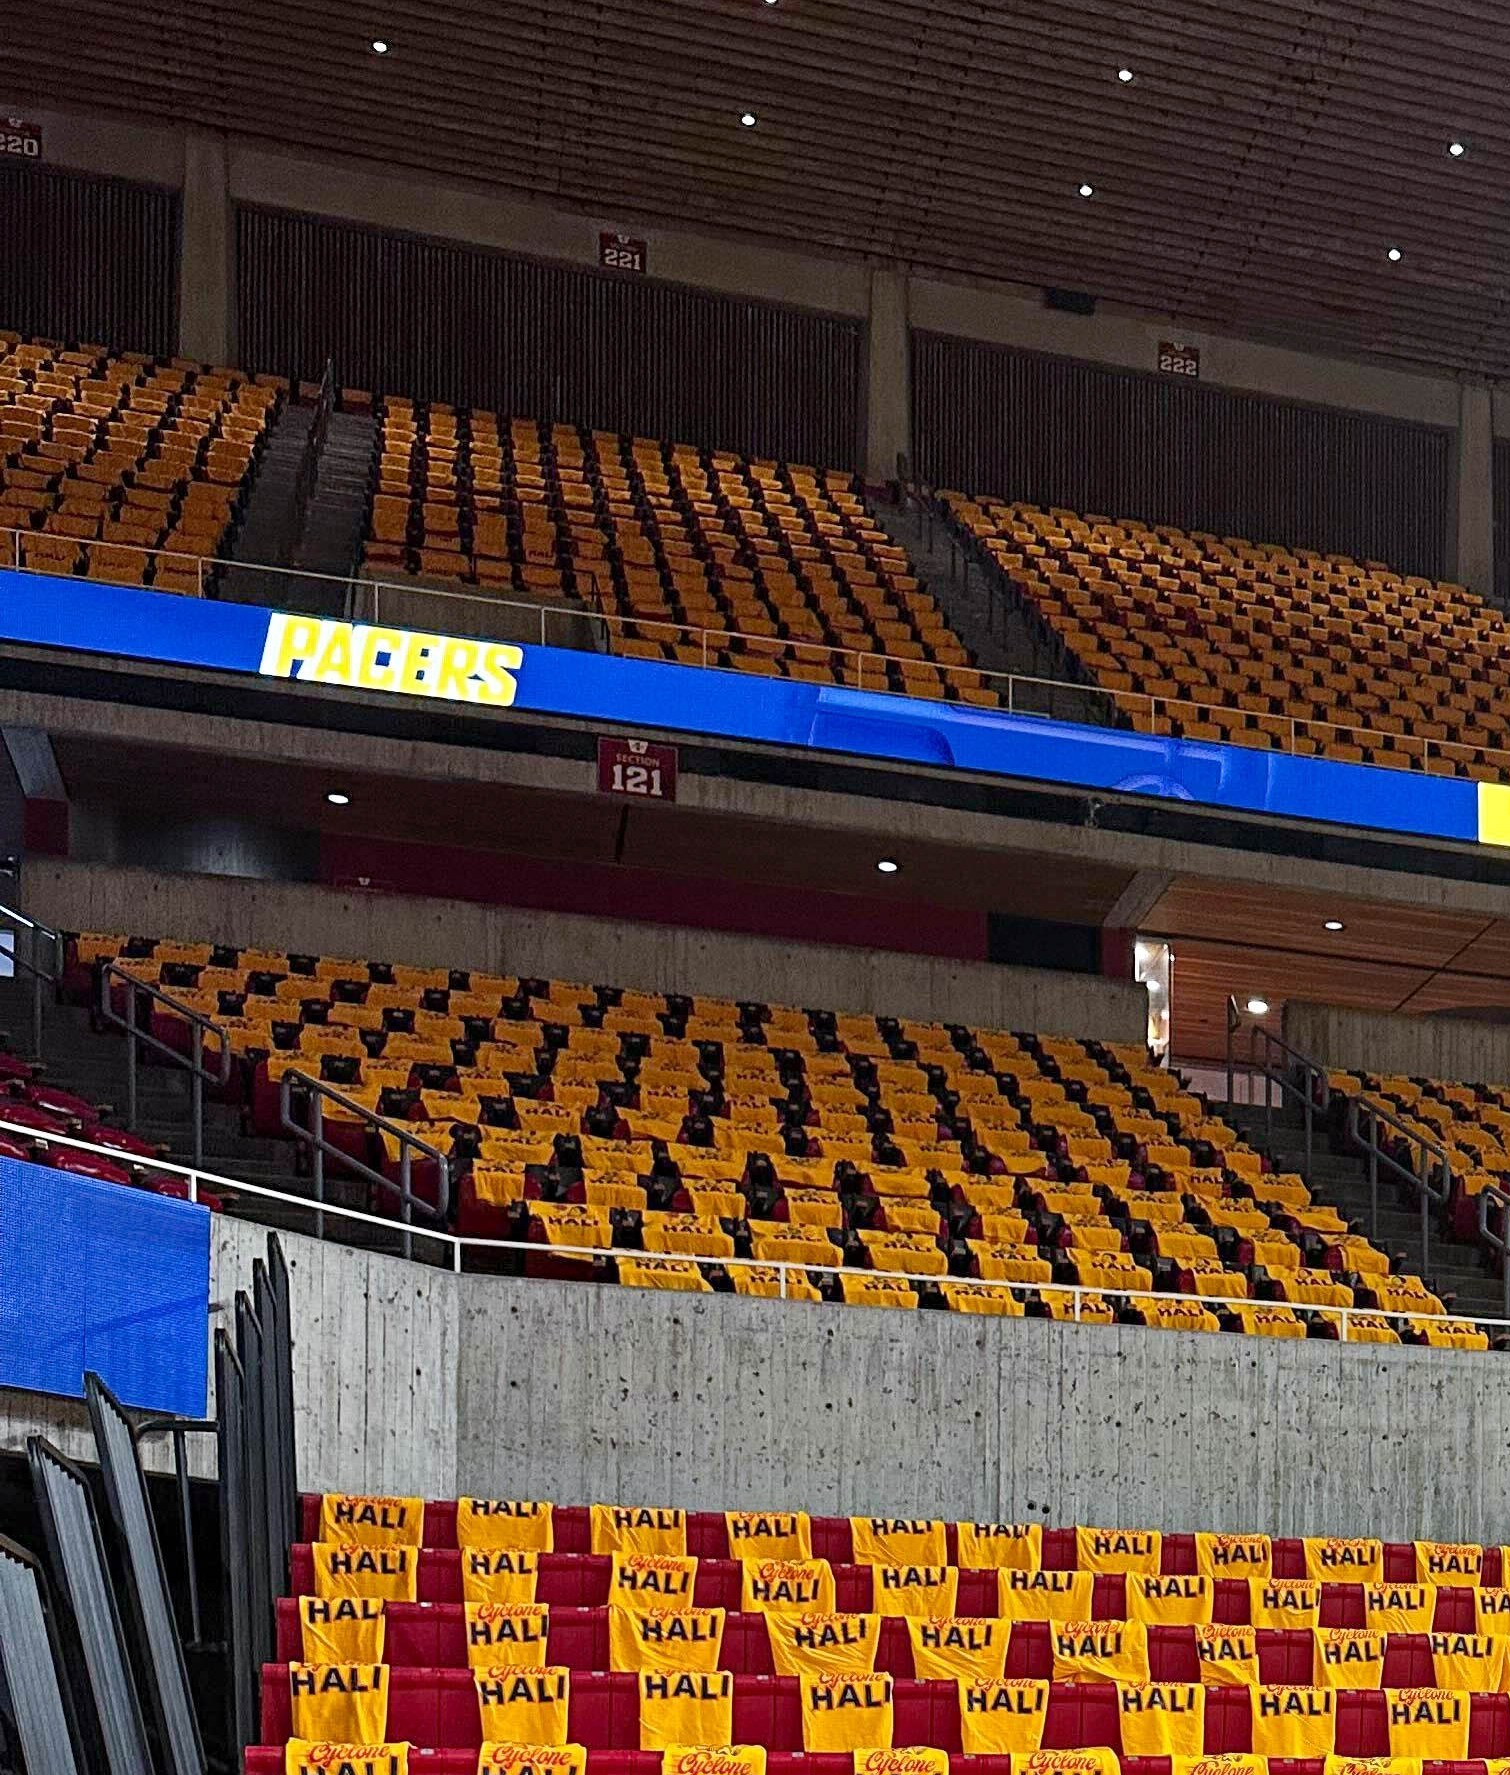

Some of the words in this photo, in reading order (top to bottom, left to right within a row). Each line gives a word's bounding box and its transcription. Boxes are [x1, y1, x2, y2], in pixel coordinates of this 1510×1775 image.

[604, 247, 642, 271] 221
[1159, 354, 1198, 377] 222
[259, 611, 524, 708] PACERS
[615, 753, 660, 767] SECTION
[612, 764, 663, 797] 121
[732, 1516, 797, 1539] HALI
[1094, 1536, 1152, 1556] HALI
[620, 1567, 688, 1594] HALI
[1011, 1571, 1072, 1592] HALI
[470, 1615, 548, 1644] HALI
[1326, 1640, 1384, 1664] HALI
[1432, 1631, 1491, 1657] HALI
[291, 1668, 380, 1696] HALI
[480, 1678, 564, 1704] HALI
[1123, 1689, 1194, 1712] HALI
